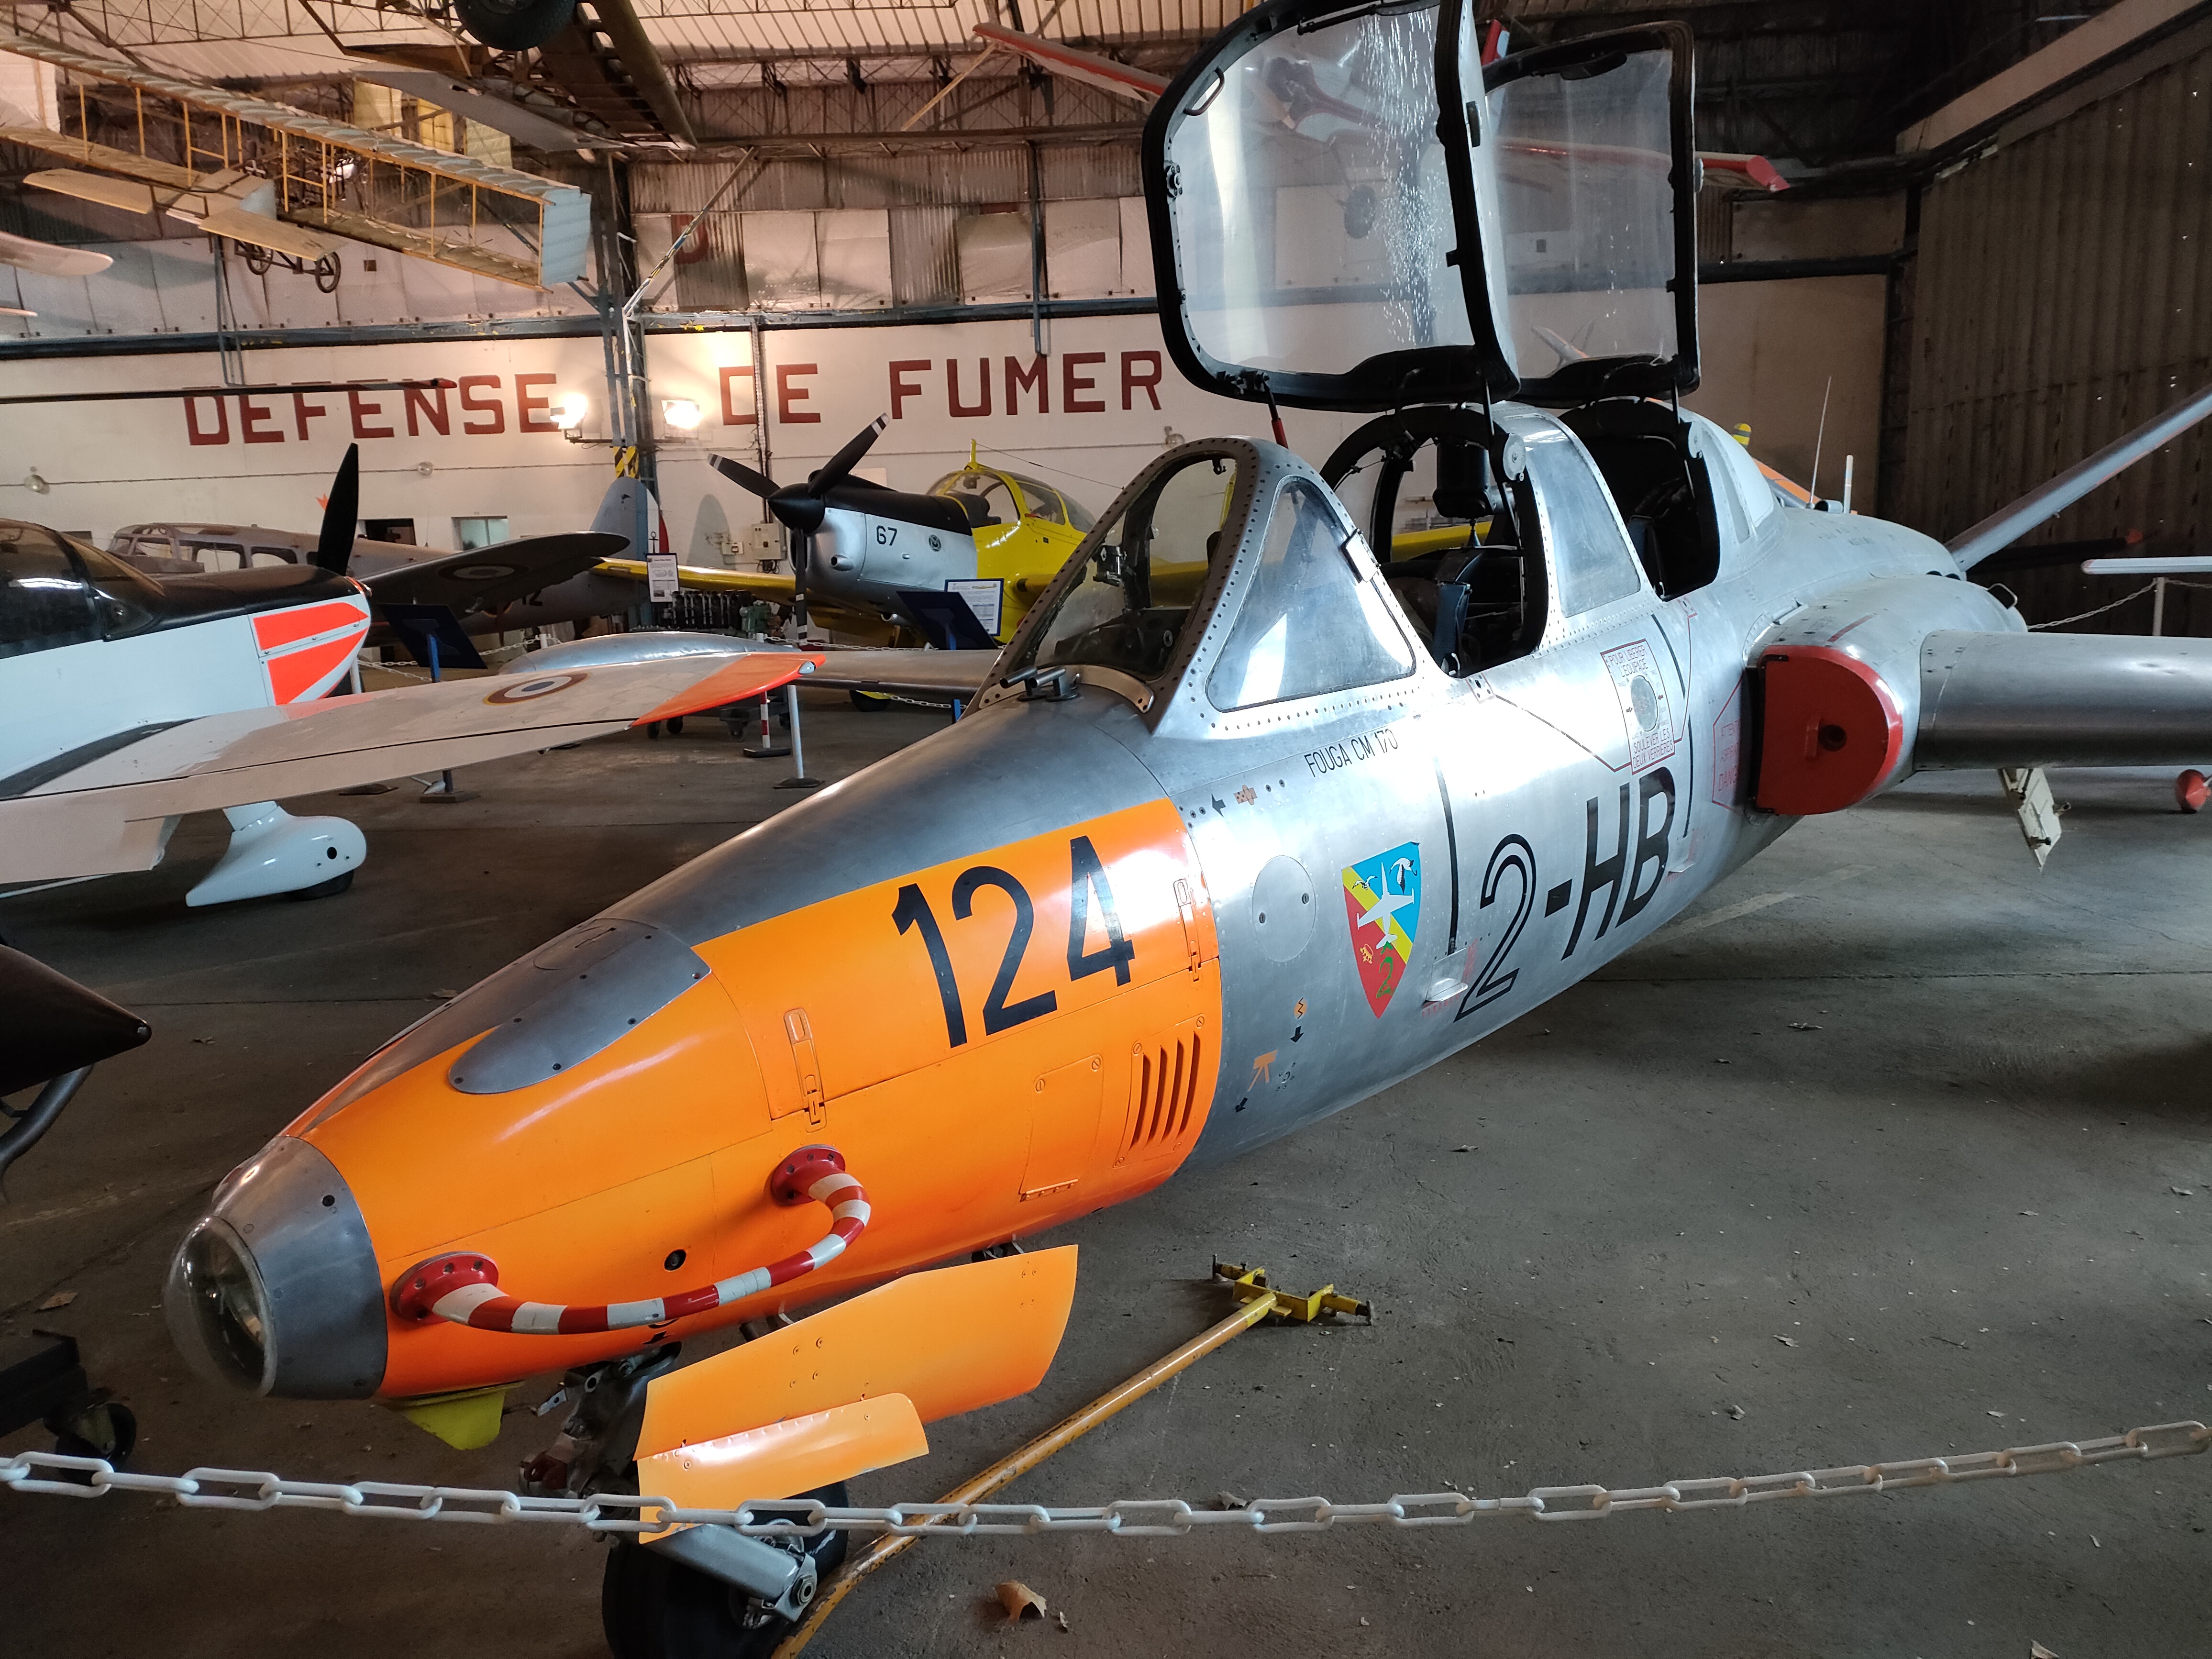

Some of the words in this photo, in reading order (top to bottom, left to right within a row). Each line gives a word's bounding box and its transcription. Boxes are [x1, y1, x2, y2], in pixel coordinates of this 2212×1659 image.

[182, 373, 562, 446] DEFENSE
[889, 350, 1162, 420] FUMER
[876, 525, 897, 546] 67
[1608, 652, 1626, 666] POUR
[1304, 743, 1353, 777] FOUGA
[1350, 735, 1375, 761] CM
[1374, 728, 1398, 753] 170
[1634, 732, 1659, 754] SOULEVER
[1659, 728, 1670, 741] LES
[1632, 754, 1647, 769] DEUX
[1453, 766, 1676, 1023] 2-HB
[891, 835, 1136, 1049] 124
